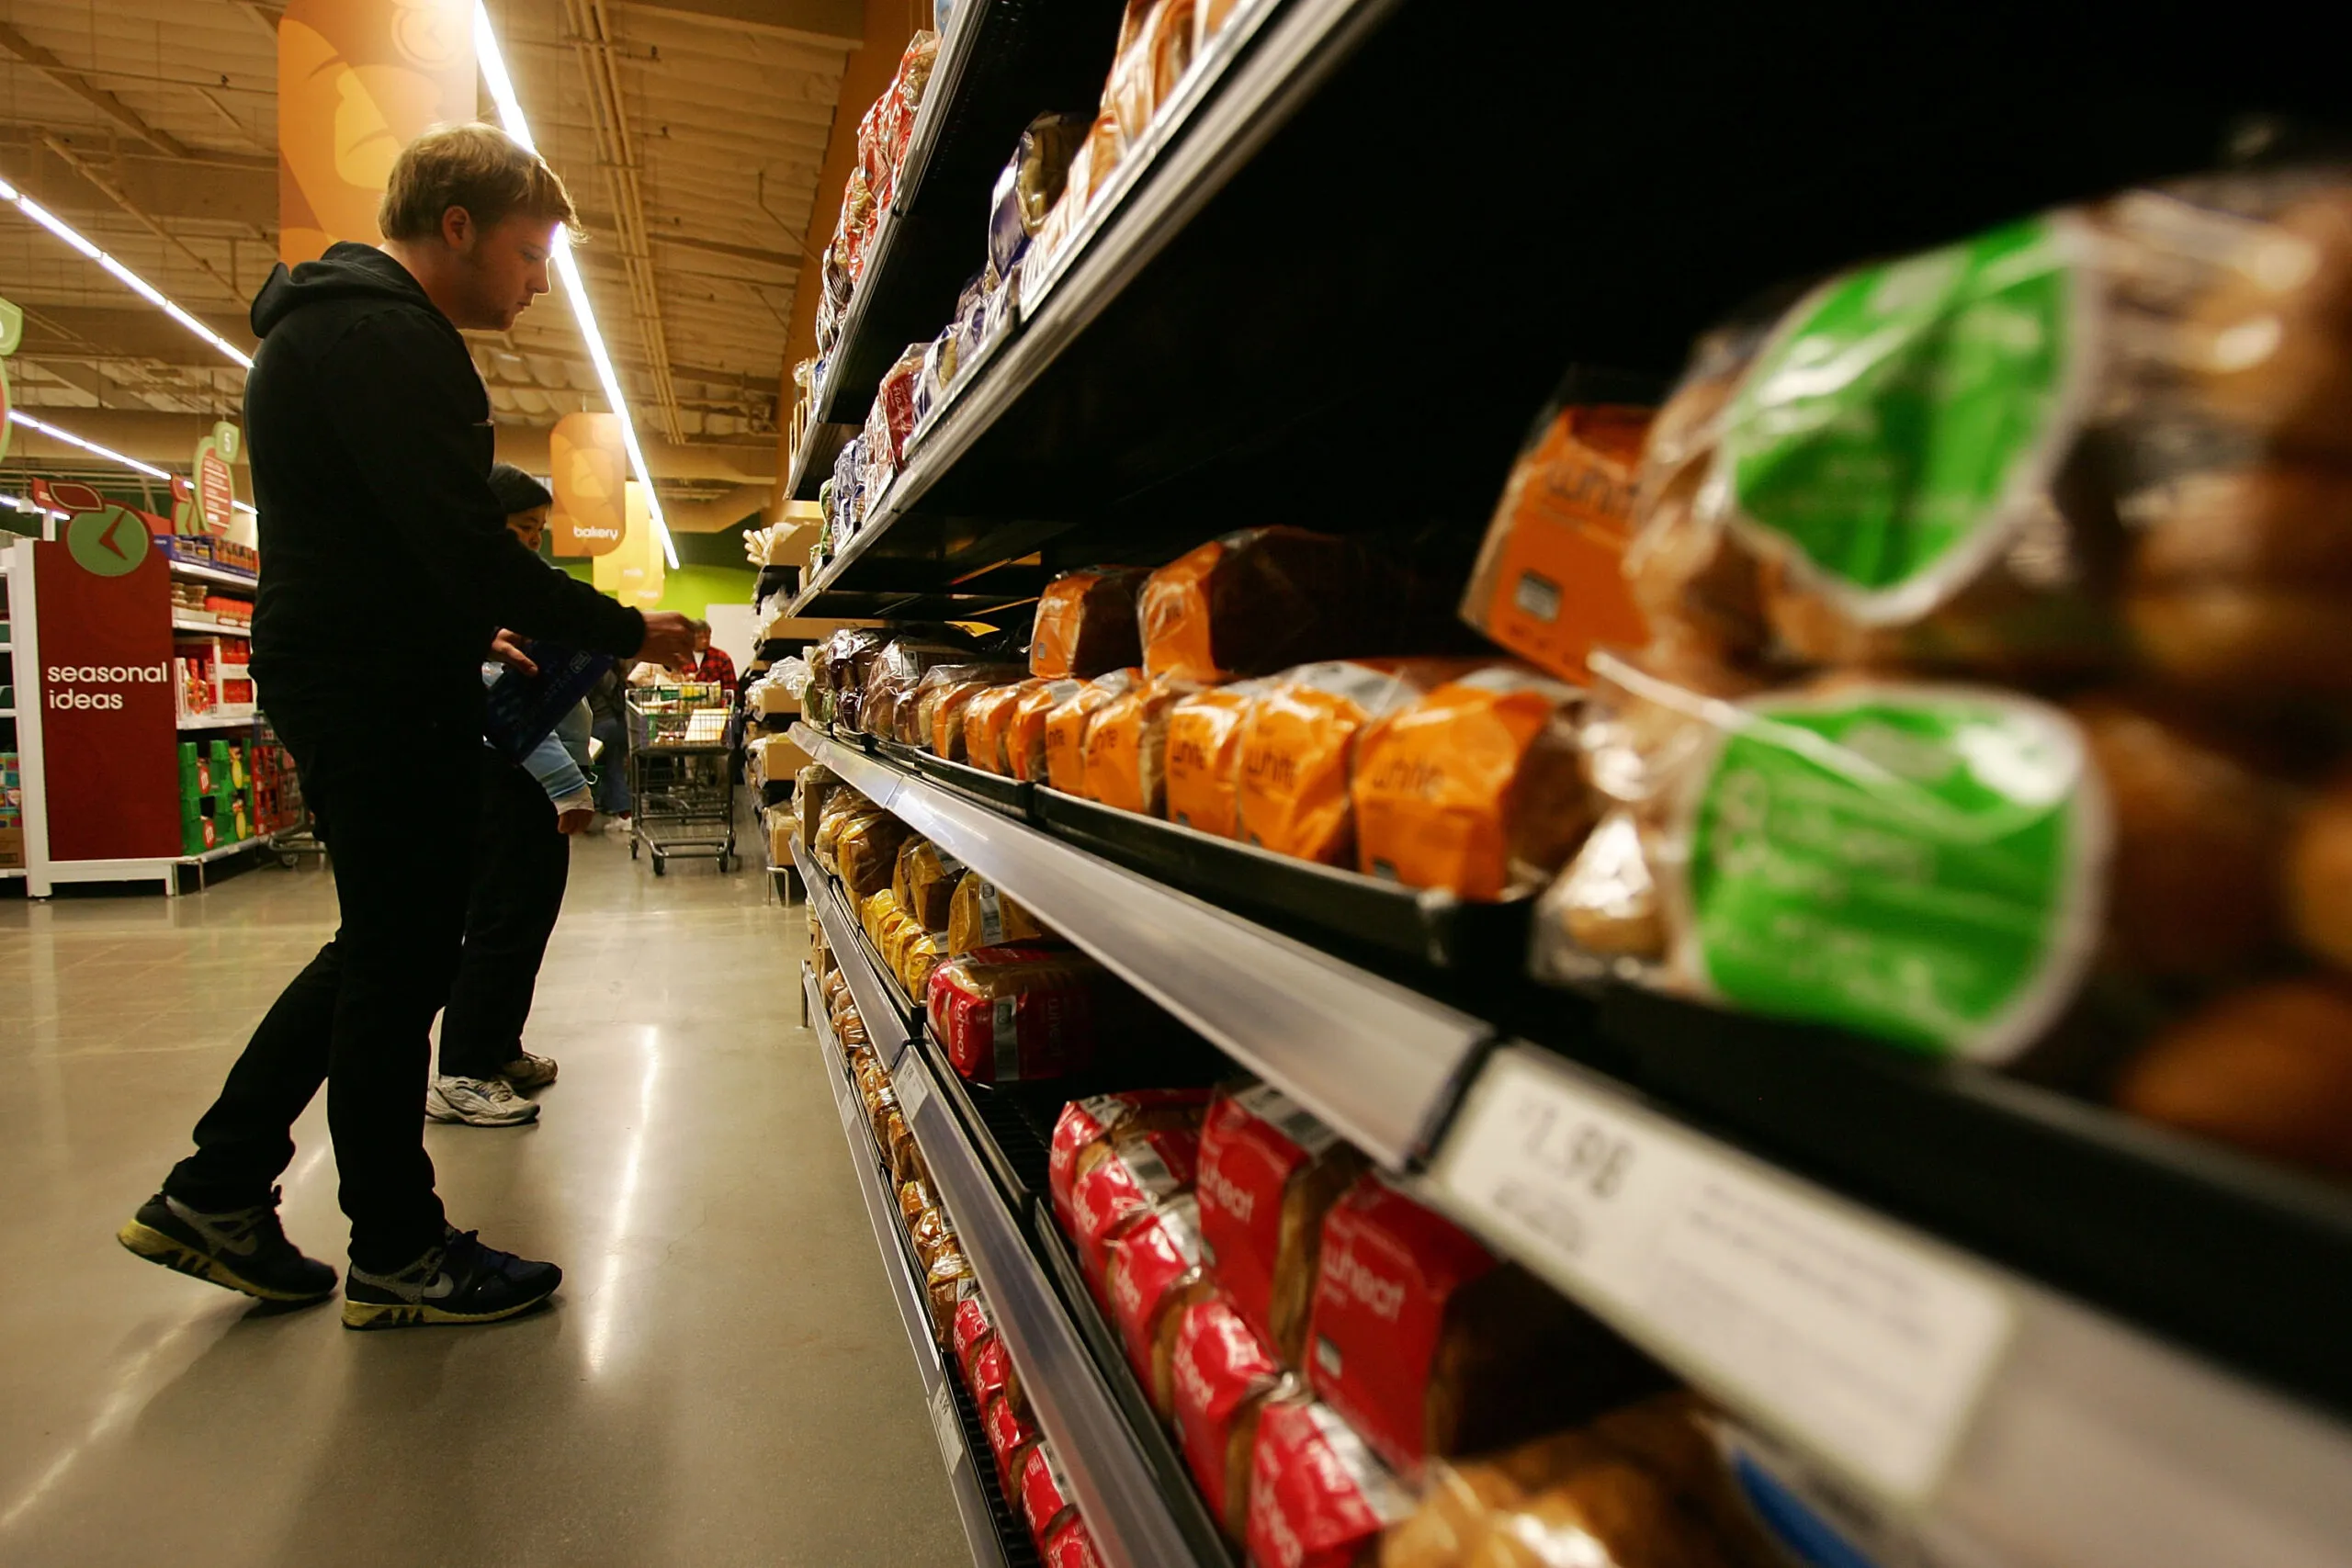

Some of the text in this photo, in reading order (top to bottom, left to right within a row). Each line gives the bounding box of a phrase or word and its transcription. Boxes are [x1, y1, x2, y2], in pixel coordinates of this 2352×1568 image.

[573, 526, 618, 540] bakery
[48, 661, 168, 682] seasonal
[49, 688, 123, 709] ideas
[955, 998, 967, 1060] wheat
[1197, 1156, 1255, 1224] wheat
[1323, 1239, 1405, 1324] wheat
